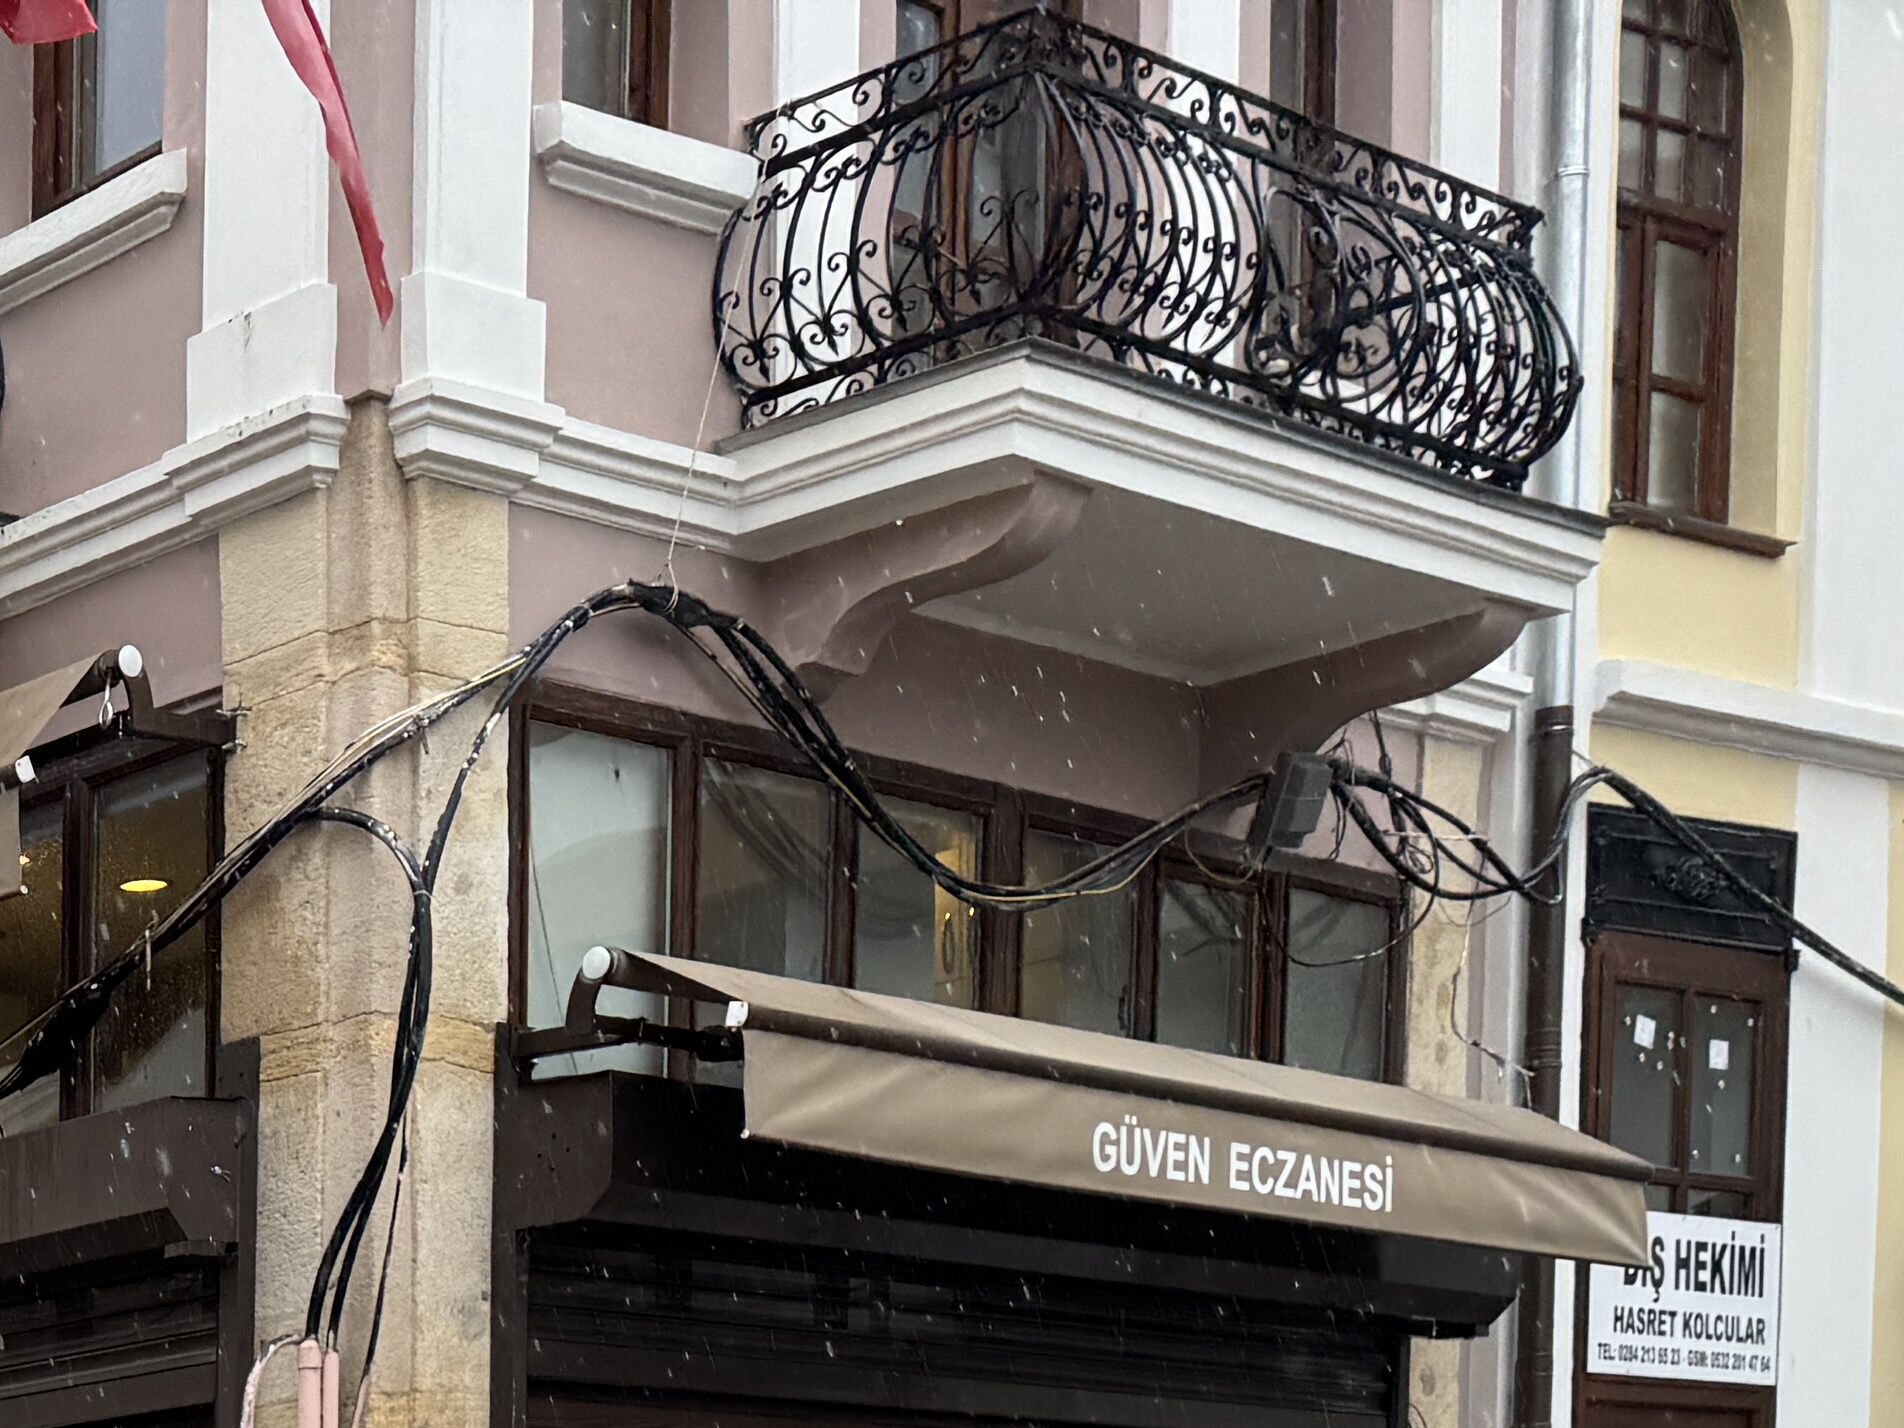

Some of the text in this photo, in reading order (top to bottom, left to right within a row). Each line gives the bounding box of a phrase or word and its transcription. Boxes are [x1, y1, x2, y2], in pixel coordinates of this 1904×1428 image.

[1092, 1114, 1393, 1213] GÜVEN ECZANESİ
[1674, 1230, 1766, 1298] HEKİMİ
[1613, 1304, 1766, 1346] HASRET KOLCULAR
